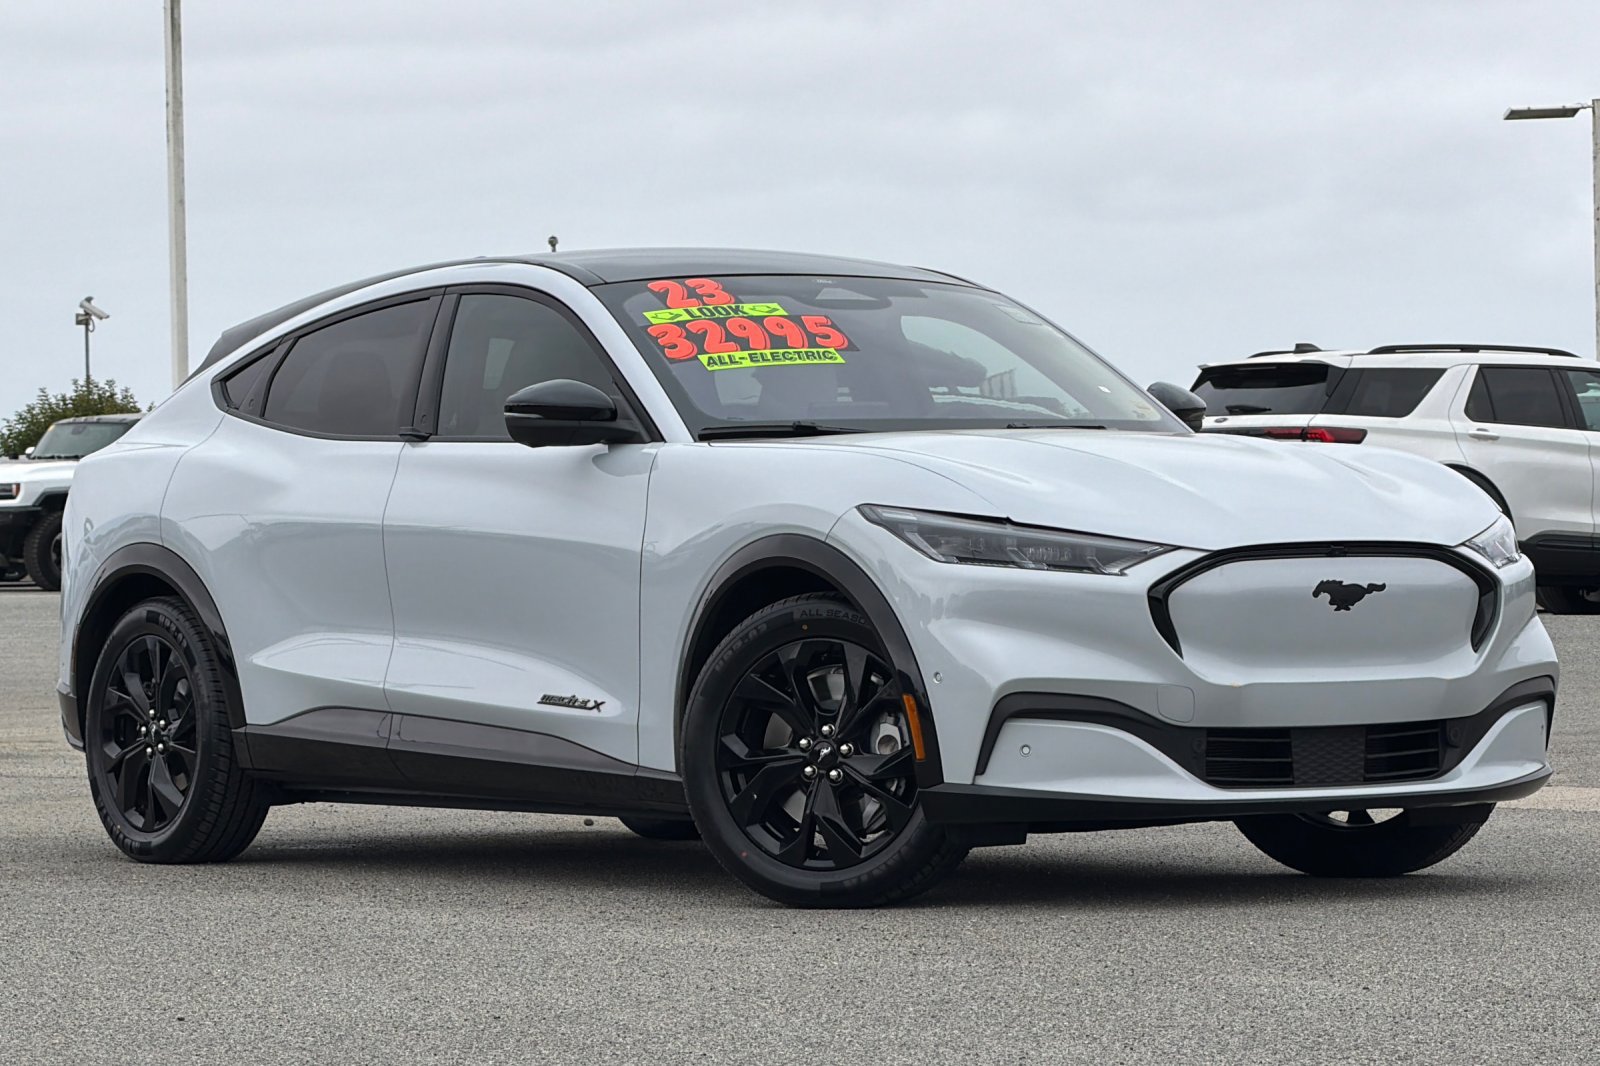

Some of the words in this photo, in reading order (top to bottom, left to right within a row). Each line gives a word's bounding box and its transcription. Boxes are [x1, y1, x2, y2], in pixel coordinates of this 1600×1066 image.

[647, 278, 735, 308] 23
[683, 305, 747, 319] LOOK
[647, 315, 849, 360] 32995
[706, 350, 837, 367] ALL-ELECTRIC
